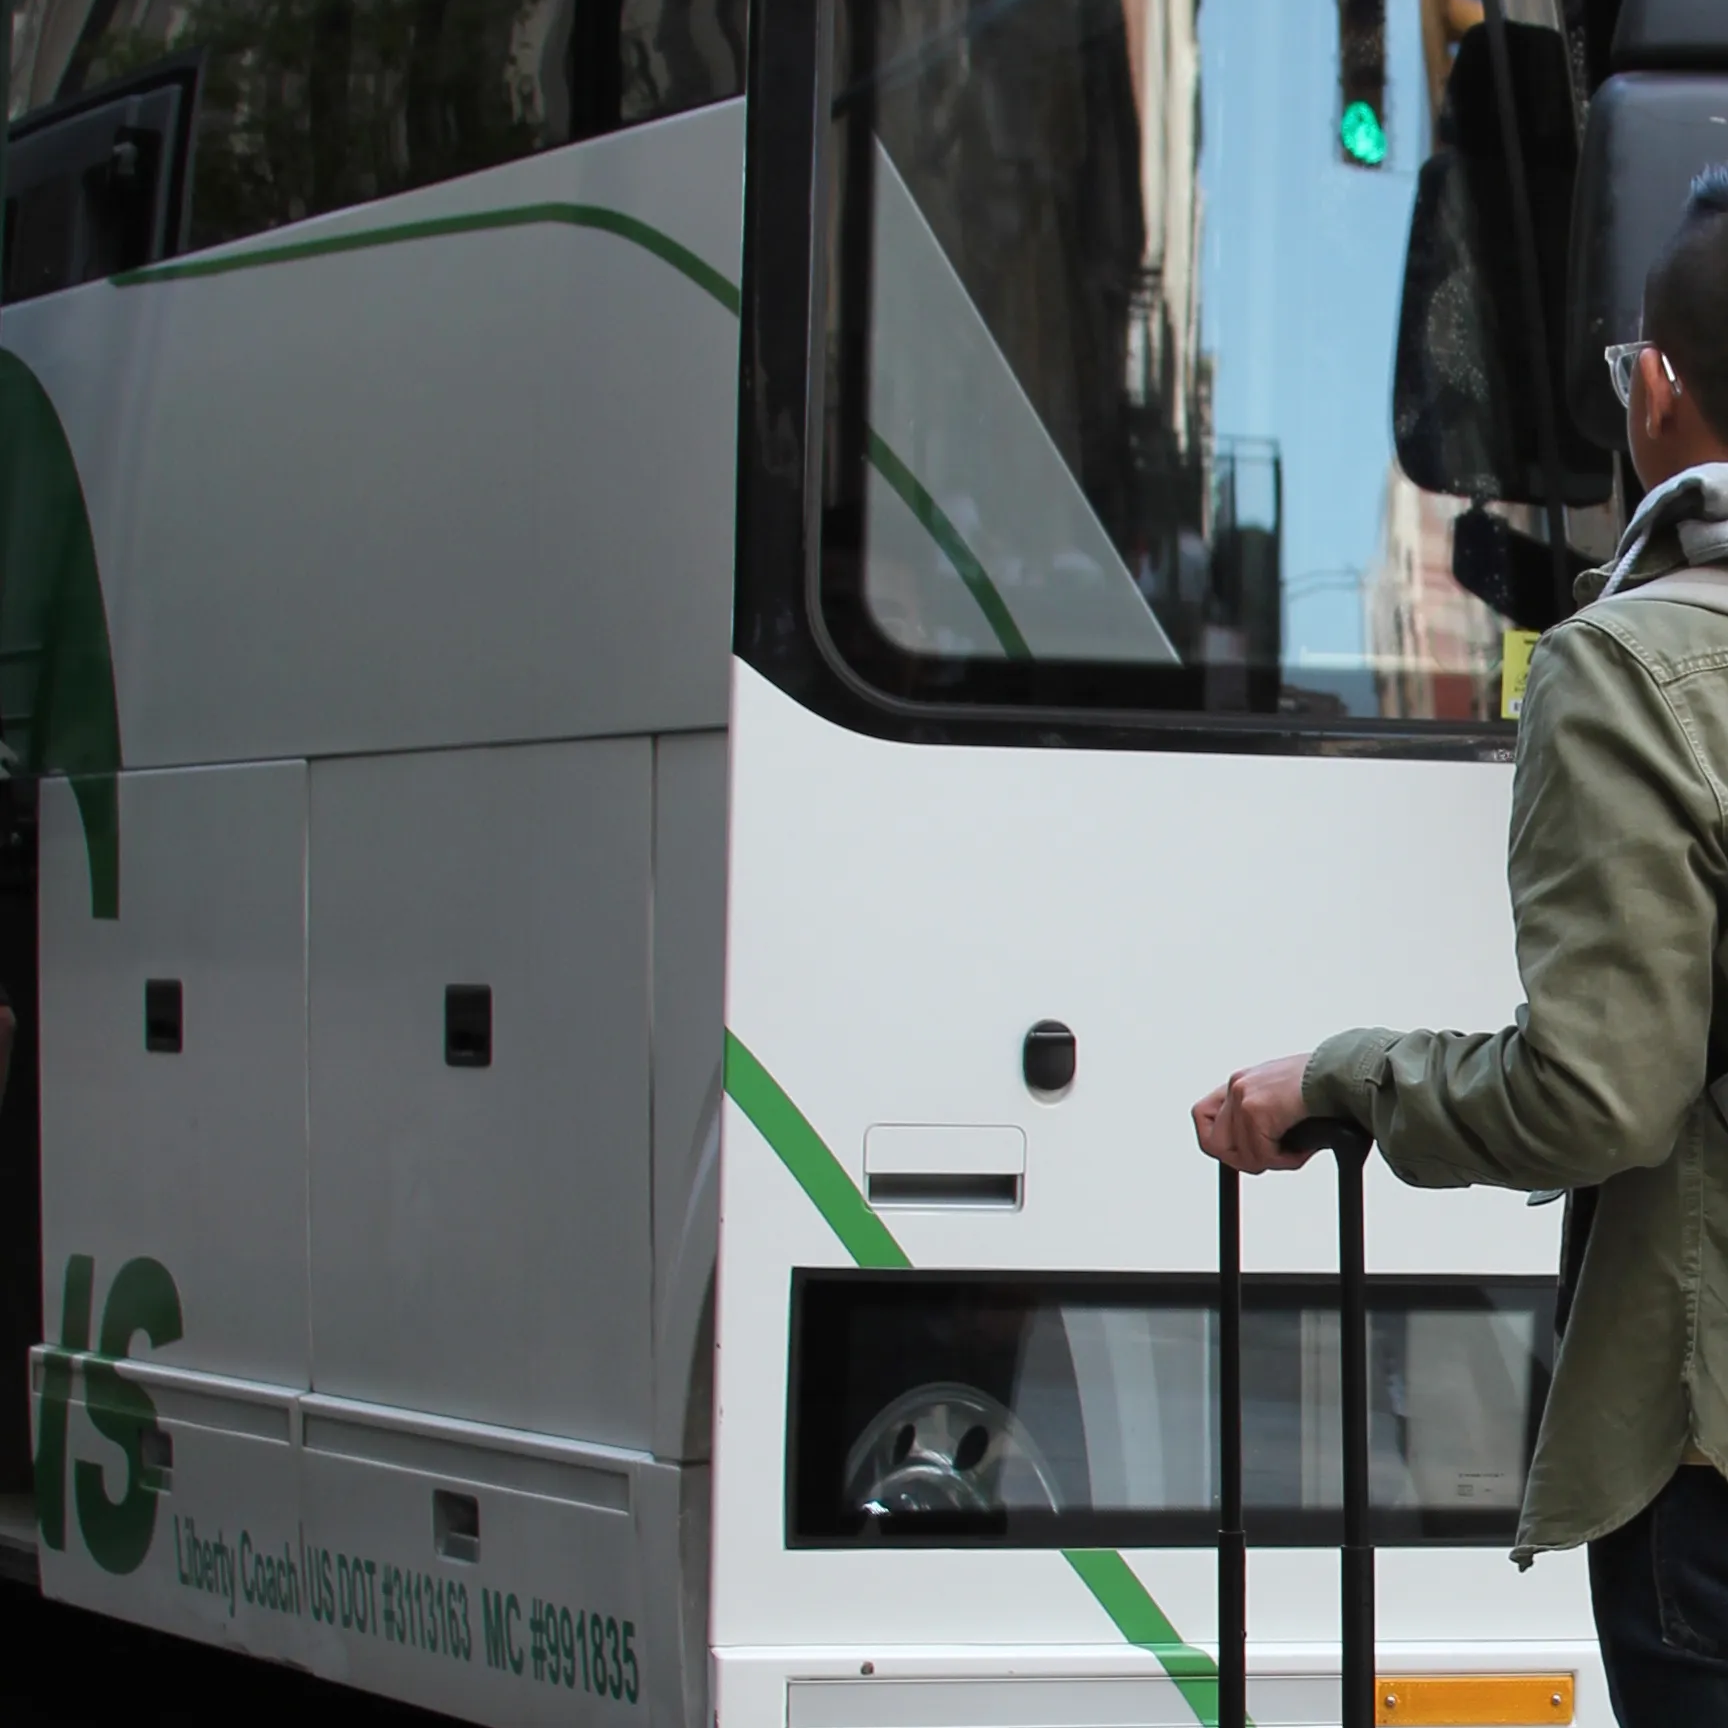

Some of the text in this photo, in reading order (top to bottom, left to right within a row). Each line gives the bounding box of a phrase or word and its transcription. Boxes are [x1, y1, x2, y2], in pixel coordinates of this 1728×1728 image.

[174, 1513, 640, 1705] Liberty Coach US DOT #3113163 MC #991835
